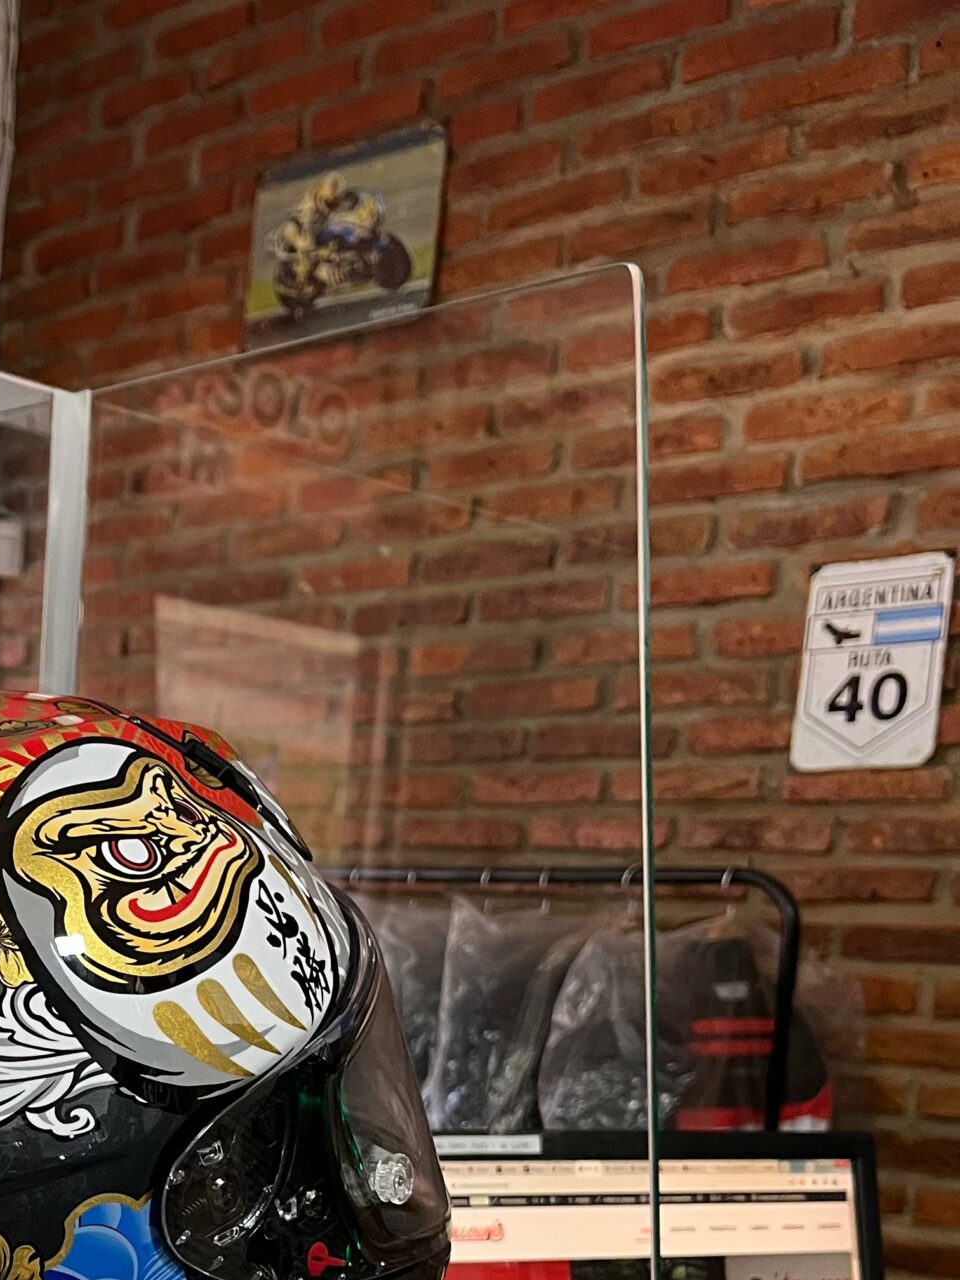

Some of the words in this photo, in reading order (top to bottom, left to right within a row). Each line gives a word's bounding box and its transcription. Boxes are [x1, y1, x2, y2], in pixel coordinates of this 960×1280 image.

[820, 582, 934, 610] ARGENTINA
[848, 650, 892, 668] RUTA
[826, 671, 908, 722] 40
